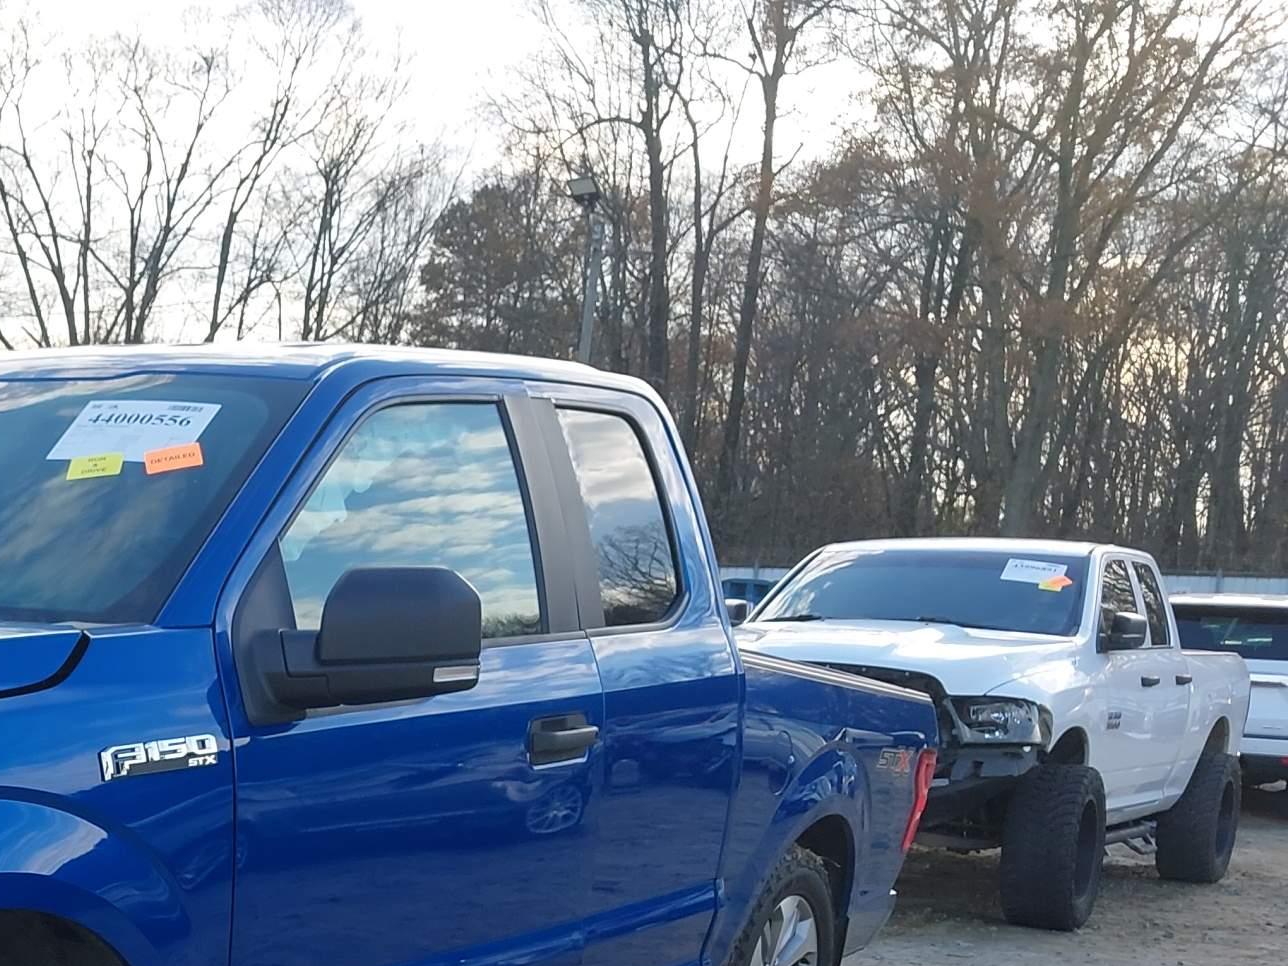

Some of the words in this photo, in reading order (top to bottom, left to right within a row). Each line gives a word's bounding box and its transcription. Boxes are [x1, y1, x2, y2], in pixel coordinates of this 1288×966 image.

[88, 412, 193, 427] 44000556
[187, 754, 217, 767] STX
[876, 747, 914, 774] STX
